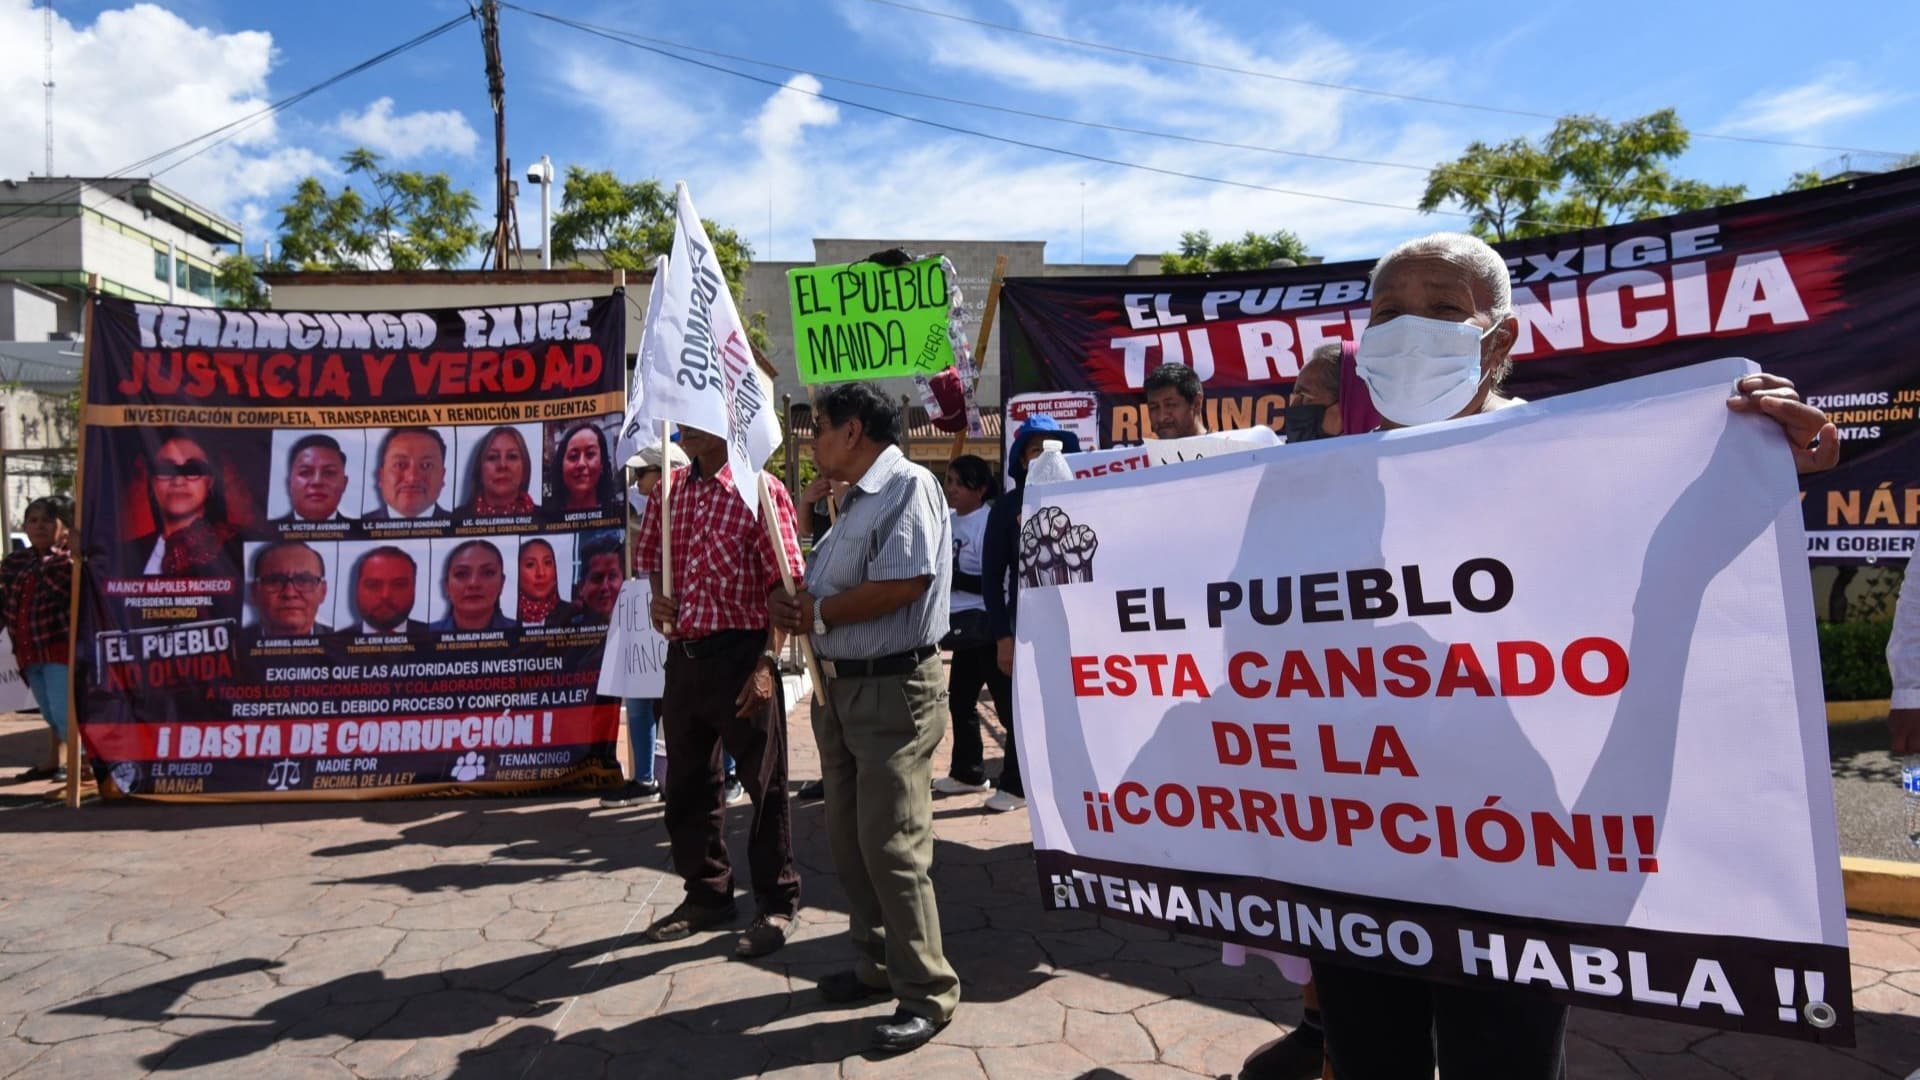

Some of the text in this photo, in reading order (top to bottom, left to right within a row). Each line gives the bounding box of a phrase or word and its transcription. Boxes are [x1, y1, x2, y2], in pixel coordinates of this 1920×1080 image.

[795, 263, 948, 316] EL PUEBLO
[1110, 250, 1809, 388] TU RENCIA
[1124, 293, 1187, 329] EL
[1201, 280, 1373, 321] PUEB
[134, 299, 593, 350] TENANCINGO EXIGE
[807, 320, 907, 375] MANDA
[914, 322, 946, 370] FUERA
[118, 351, 351, 400] JUSTICIA
[361, 352, 396, 397] Y
[408, 343, 602, 396] VERDAD
[123, 399, 597, 427] INVESTIGACIÓN COMPLETA, TRANSPARENCIA Y RENDICIÓN DE CUENTAS
[1054, 399, 1088, 409] EXIGIMOS
[1806, 391, 1889, 408] EXIGIMOS
[1837, 426, 1881, 441] NTAS
[1836, 536, 1915, 552] GOBIER
[107, 578, 232, 593] NANCY NÁPOLES PACHECO
[1116, 557, 1514, 633] EL PUEBLO
[124, 597, 174, 608] PRESIDENTA
[142, 607, 198, 619] TENANCINGO
[105, 626, 229, 663] EL PUEBLO
[624, 635, 665, 676] NANC
[106, 654, 232, 692] NO OLVIDA
[266, 657, 563, 682] EXIGIMOS QUE LAS AUTORIDADES INVESTIGUEN
[1071, 637, 1631, 700] ESTA CANSADO
[220, 685, 261, 699] TODOS
[265, 685, 290, 698] LOS
[294, 681, 391, 697] FUNCIONARIOS
[393, 681, 401, 693] Y
[405, 677, 516, 694] COLABORADORES
[232, 688, 589, 717] RESPETANDO EL DEBIDO PROCESO Y CONFORME A LA LEY
[178, 723, 281, 759] BASTA
[289, 722, 329, 755] DE
[336, 709, 534, 754] CORRUPCIÓN
[499, 751, 571, 767] TENANCINGO
[1211, 720, 1419, 778] DE LA
[152, 762, 213, 777] EL PUEBLO
[316, 757, 378, 773] NADIE POR
[495, 768, 538, 781] MERECE
[154, 778, 204, 793] MANDA
[312, 771, 416, 789] ENCIMA DE LA LEY
[1083, 782, 1659, 874] ¡¡CORRUPCIÓN!!
[1457, 928, 1745, 1016] HABLA
